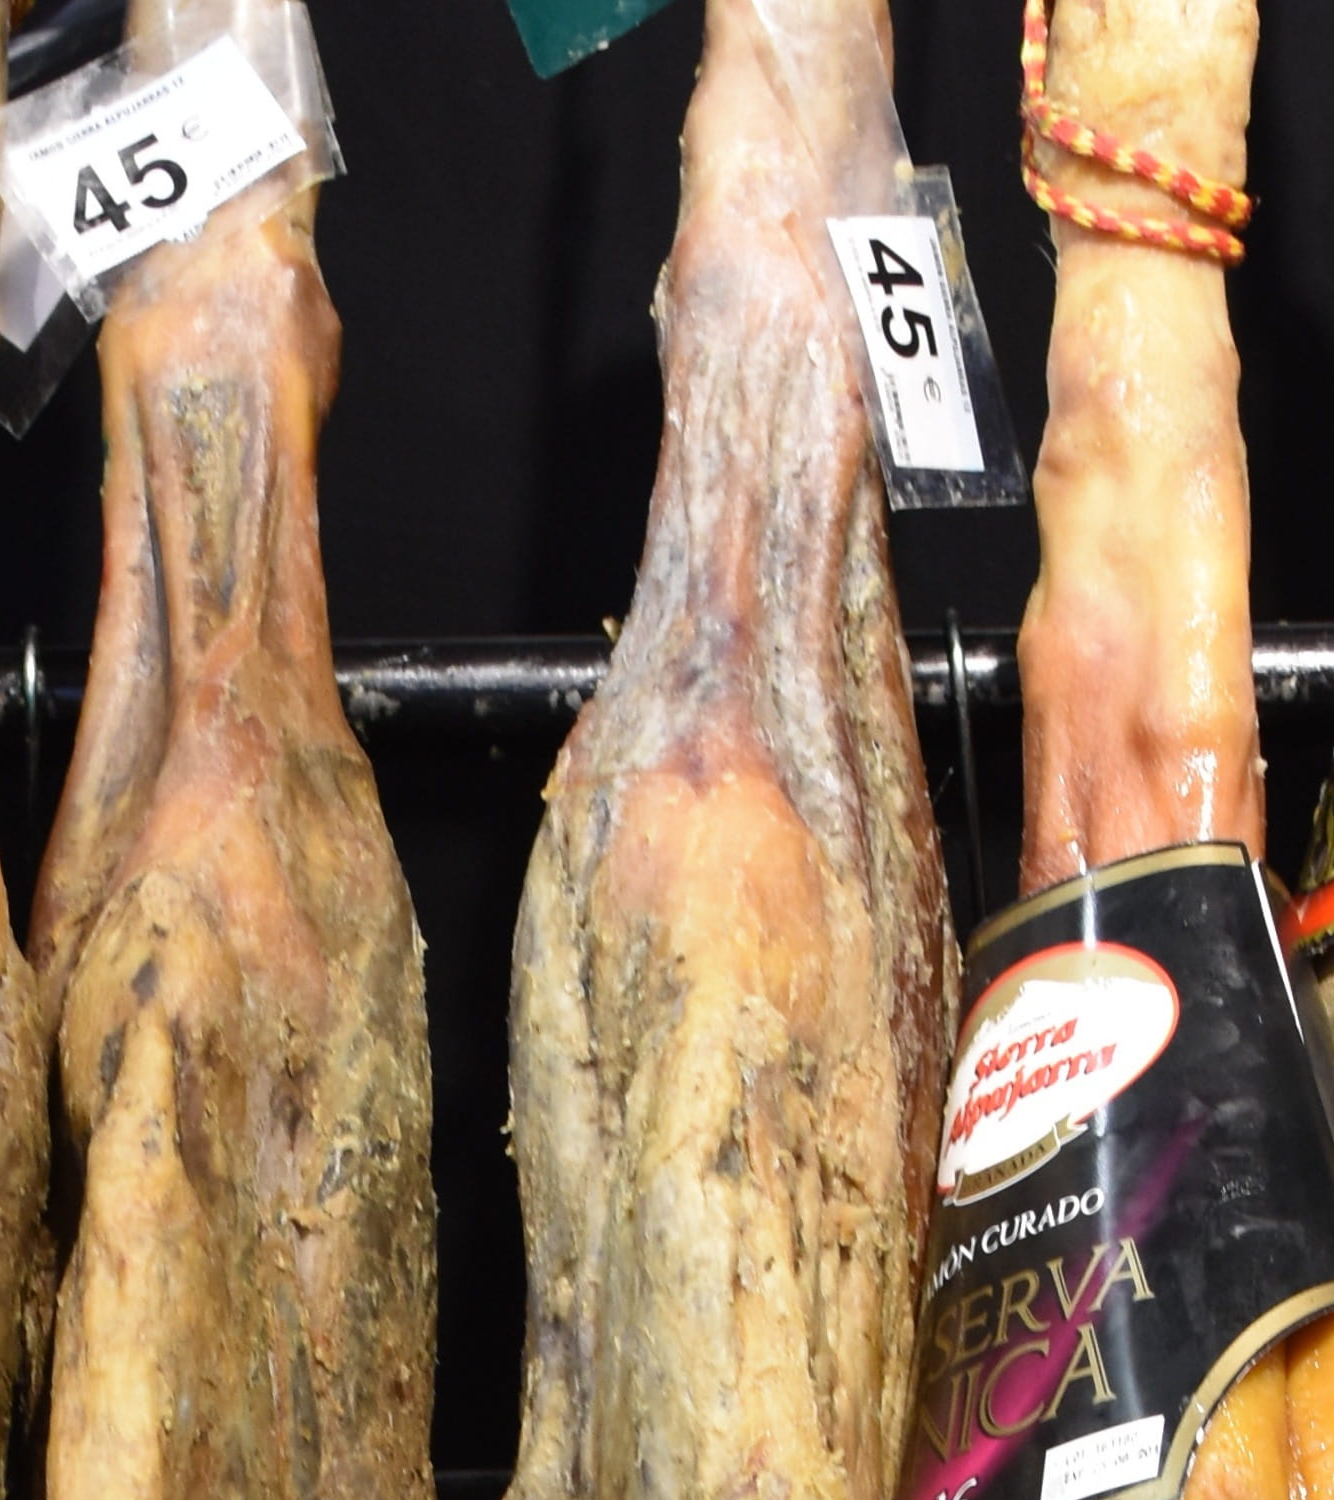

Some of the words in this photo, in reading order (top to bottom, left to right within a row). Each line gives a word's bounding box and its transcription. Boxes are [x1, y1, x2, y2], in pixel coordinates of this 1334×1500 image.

[73, 133, 188, 235] 45
[866, 236, 935, 359] 45
[922, 378, 944, 404] €
[970, 1018, 1078, 1094] Sierra
[981, 1187, 1105, 1257] CURADO
